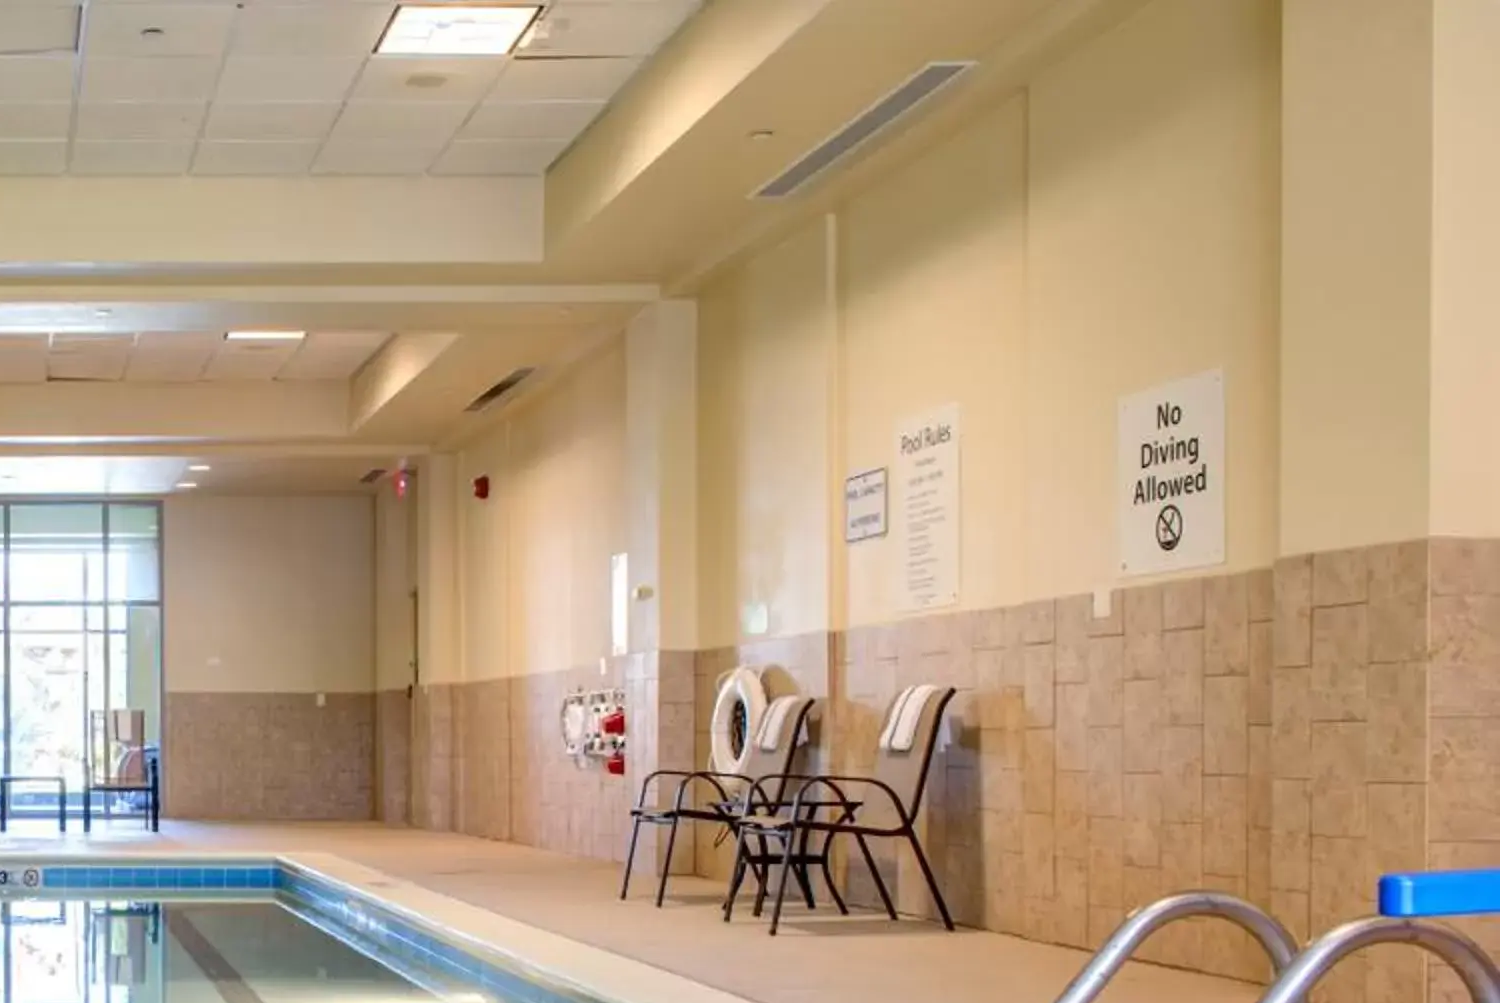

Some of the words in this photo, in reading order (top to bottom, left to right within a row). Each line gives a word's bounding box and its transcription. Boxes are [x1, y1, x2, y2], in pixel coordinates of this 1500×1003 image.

[1157, 402, 1182, 430] No
[900, 429, 922, 455] Pool
[924, 423, 952, 449] Rules
[1141, 436, 1199, 469] Diving
[1133, 463, 1207, 505] Allowed
